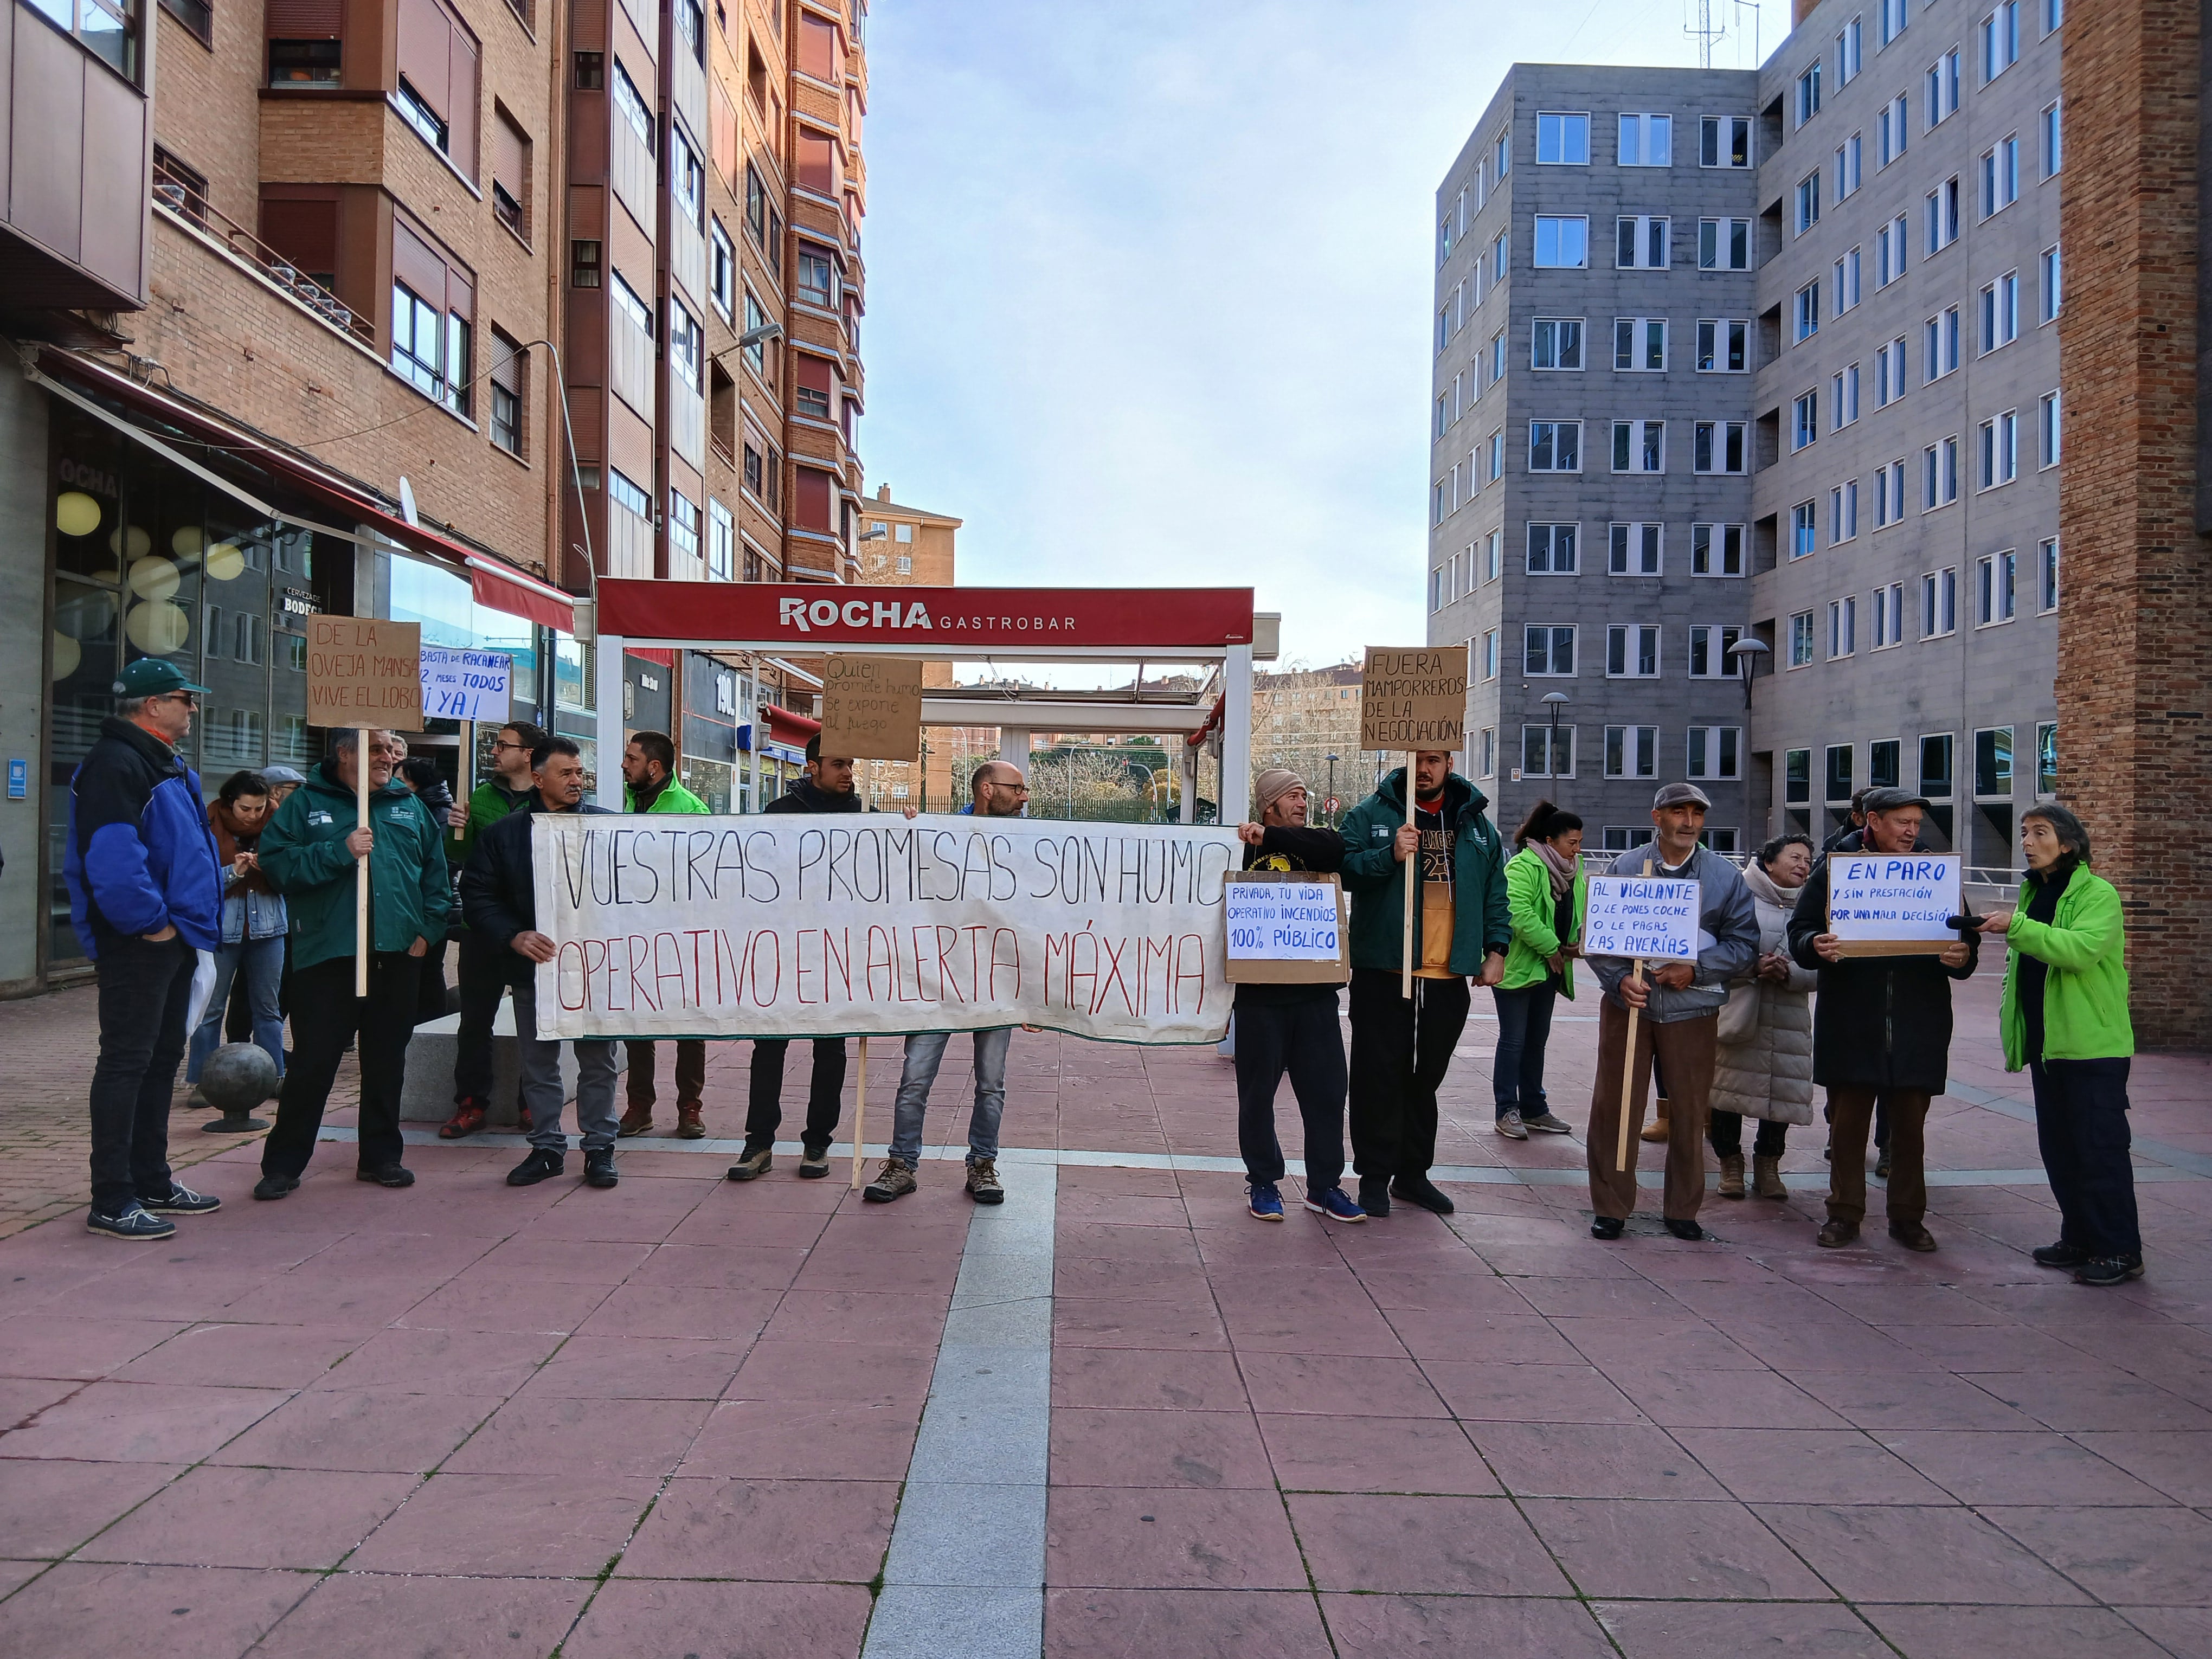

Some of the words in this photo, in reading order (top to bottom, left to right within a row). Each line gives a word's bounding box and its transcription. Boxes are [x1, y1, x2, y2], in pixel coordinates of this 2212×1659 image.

[287, 587, 313, 601] CERVEZA
[313, 595, 321, 603] DE
[780, 597, 933, 632] ROCHA
[940, 616, 1075, 630] GASTROBAR
[317, 623, 346, 645] DE
[356, 626, 377, 646] LA
[312, 653, 364, 677] OVEJA
[373, 655, 419, 678] MANSA
[420, 651, 447, 664] BASTA
[827, 658, 880, 680] Quien
[435, 674, 456, 683] MESES
[463, 673, 506, 692] TODOS
[826, 679, 881, 696] promete
[886, 678, 919, 696] humo
[1366, 677, 1465, 697] MAMPORREROS
[312, 685, 350, 707] VIVE
[356, 686, 378, 707] EL
[382, 686, 420, 709] LOBO
[847, 699, 899, 715] expone
[1365, 702, 1385, 718] DE
[1392, 700, 1411, 718] LA
[847, 716, 887, 735] fuego
[1365, 716, 1463, 743] NEGOCIACIÓN!
[561, 829, 780, 909] VUESTRAS
[799, 828, 1016, 904] PROMESAS
[1031, 835, 1108, 905] SON
[1118, 839, 1231, 905] HUMO
[1848, 863, 1877, 880] EN
[1886, 861, 1945, 880] PARO
[1279, 888, 1291, 900] TU
[1593, 882, 1609, 896] AL
[1870, 886, 1932, 899] PRESTACIÓN
[1228, 906, 1275, 919] OPERATIVO
[1591, 904, 1599, 913] O
[1604, 904, 1617, 913] LE
[1622, 904, 1649, 914] PONES
[1654, 906, 1689, 916] COCHE
[1830, 909, 1850, 920] POR
[1854, 909, 1870, 919] UNA
[1873, 910, 1896, 919] MALA
[1594, 921, 1603, 929] O
[1611, 922, 1624, 930] LE
[1633, 921, 1668, 931] PAGAS
[1231, 926, 1263, 949] 100%
[1587, 935, 1614, 949] LAS
[1624, 934, 1689, 955] AVERÍAS
[558, 929, 780, 1012] OPERATIVO
[797, 927, 852, 1004] EN
[867, 925, 1021, 1003] ALERTA
[1044, 919, 1205, 1017] MÁXIMA
